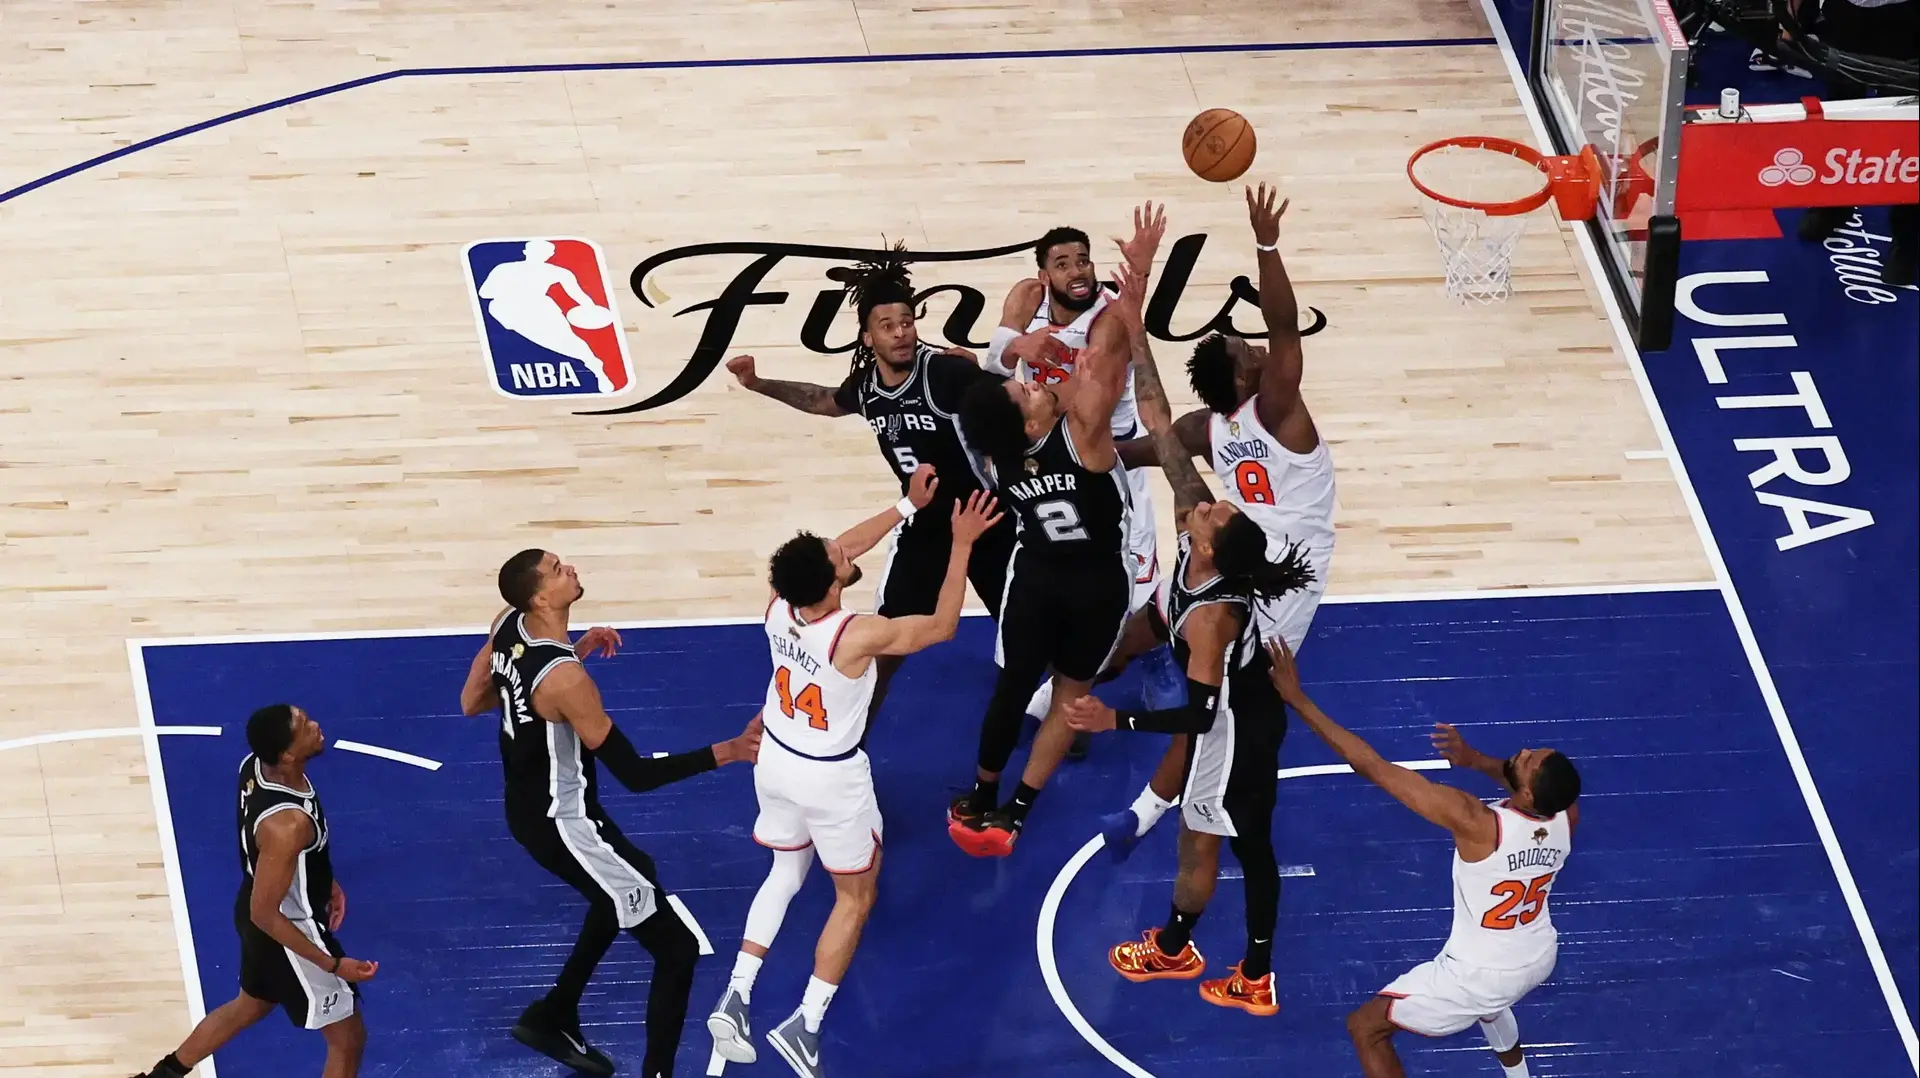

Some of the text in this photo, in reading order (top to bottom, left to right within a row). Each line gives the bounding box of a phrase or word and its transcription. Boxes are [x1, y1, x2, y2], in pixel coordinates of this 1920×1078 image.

[1820, 147, 1918, 184] State
[571, 233, 1328, 413] Finls
[509, 361, 582, 390] NBA
[1674, 270, 1876, 552] ULTRA
[893, 446, 920, 474] 5
[1008, 473, 1077, 501] HARPER
[1234, 460, 1276, 507] 8
[1033, 499, 1092, 542] 2
[772, 634, 822, 676] SHAMET
[490, 651, 534, 724] MBANYAMA
[774, 665, 829, 732] 44
[1506, 847, 1562, 872] BRIDGES
[1480, 871, 1557, 930] 25
